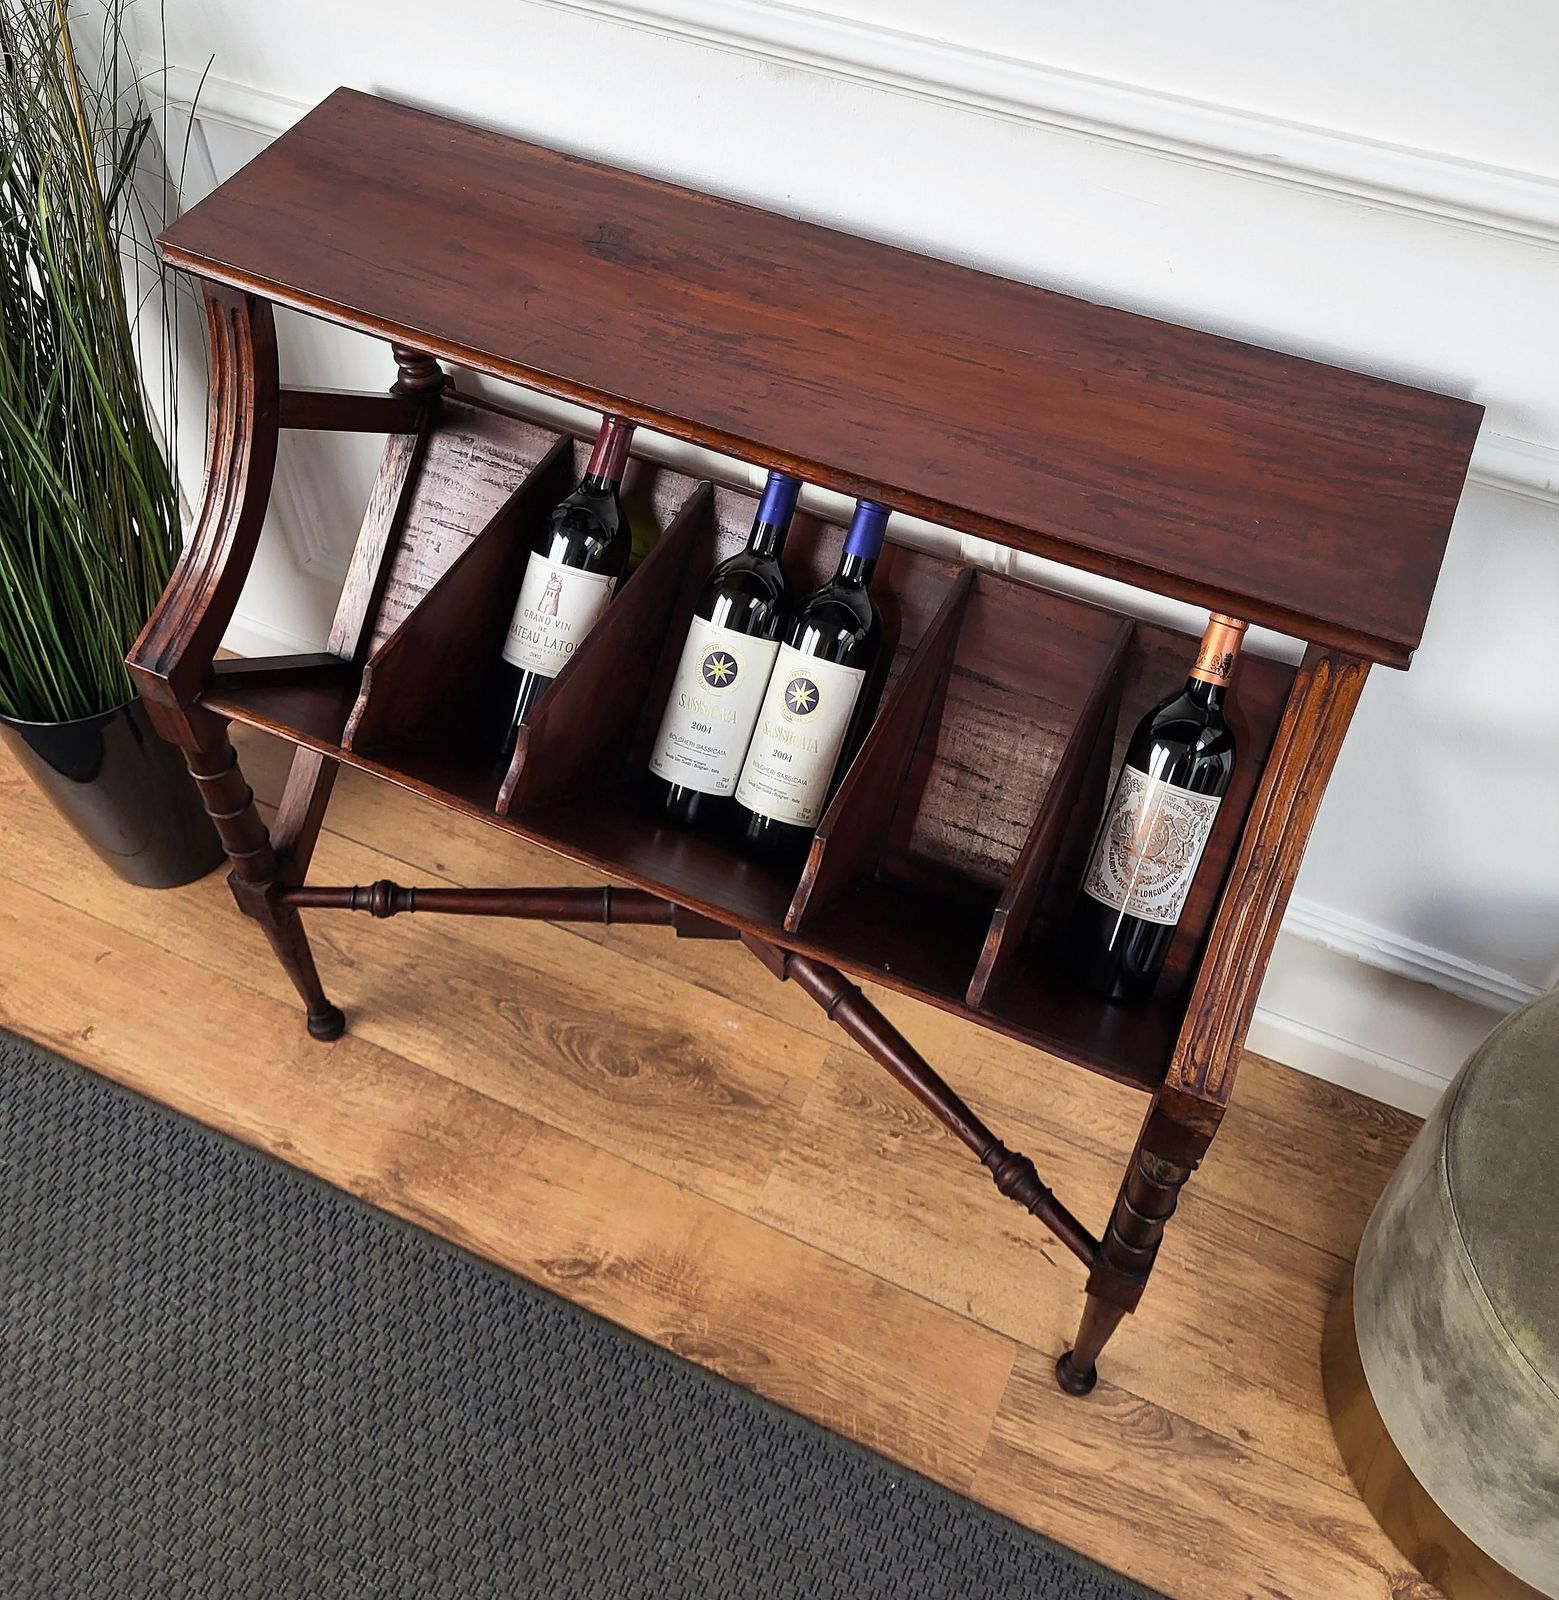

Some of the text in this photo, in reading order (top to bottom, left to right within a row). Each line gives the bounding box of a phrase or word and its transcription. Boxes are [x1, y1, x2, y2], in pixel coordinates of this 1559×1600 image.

[523, 608, 572, 632] GRAND VIN
[538, 625, 548, 633] DE
[690, 721, 712, 735] 2004
[669, 732, 696, 748] BOLGHERI
[695, 743, 727, 757] SASSICAIA
[771, 748, 793, 763] 2004
[776, 771, 808, 786] SASSICAIA
